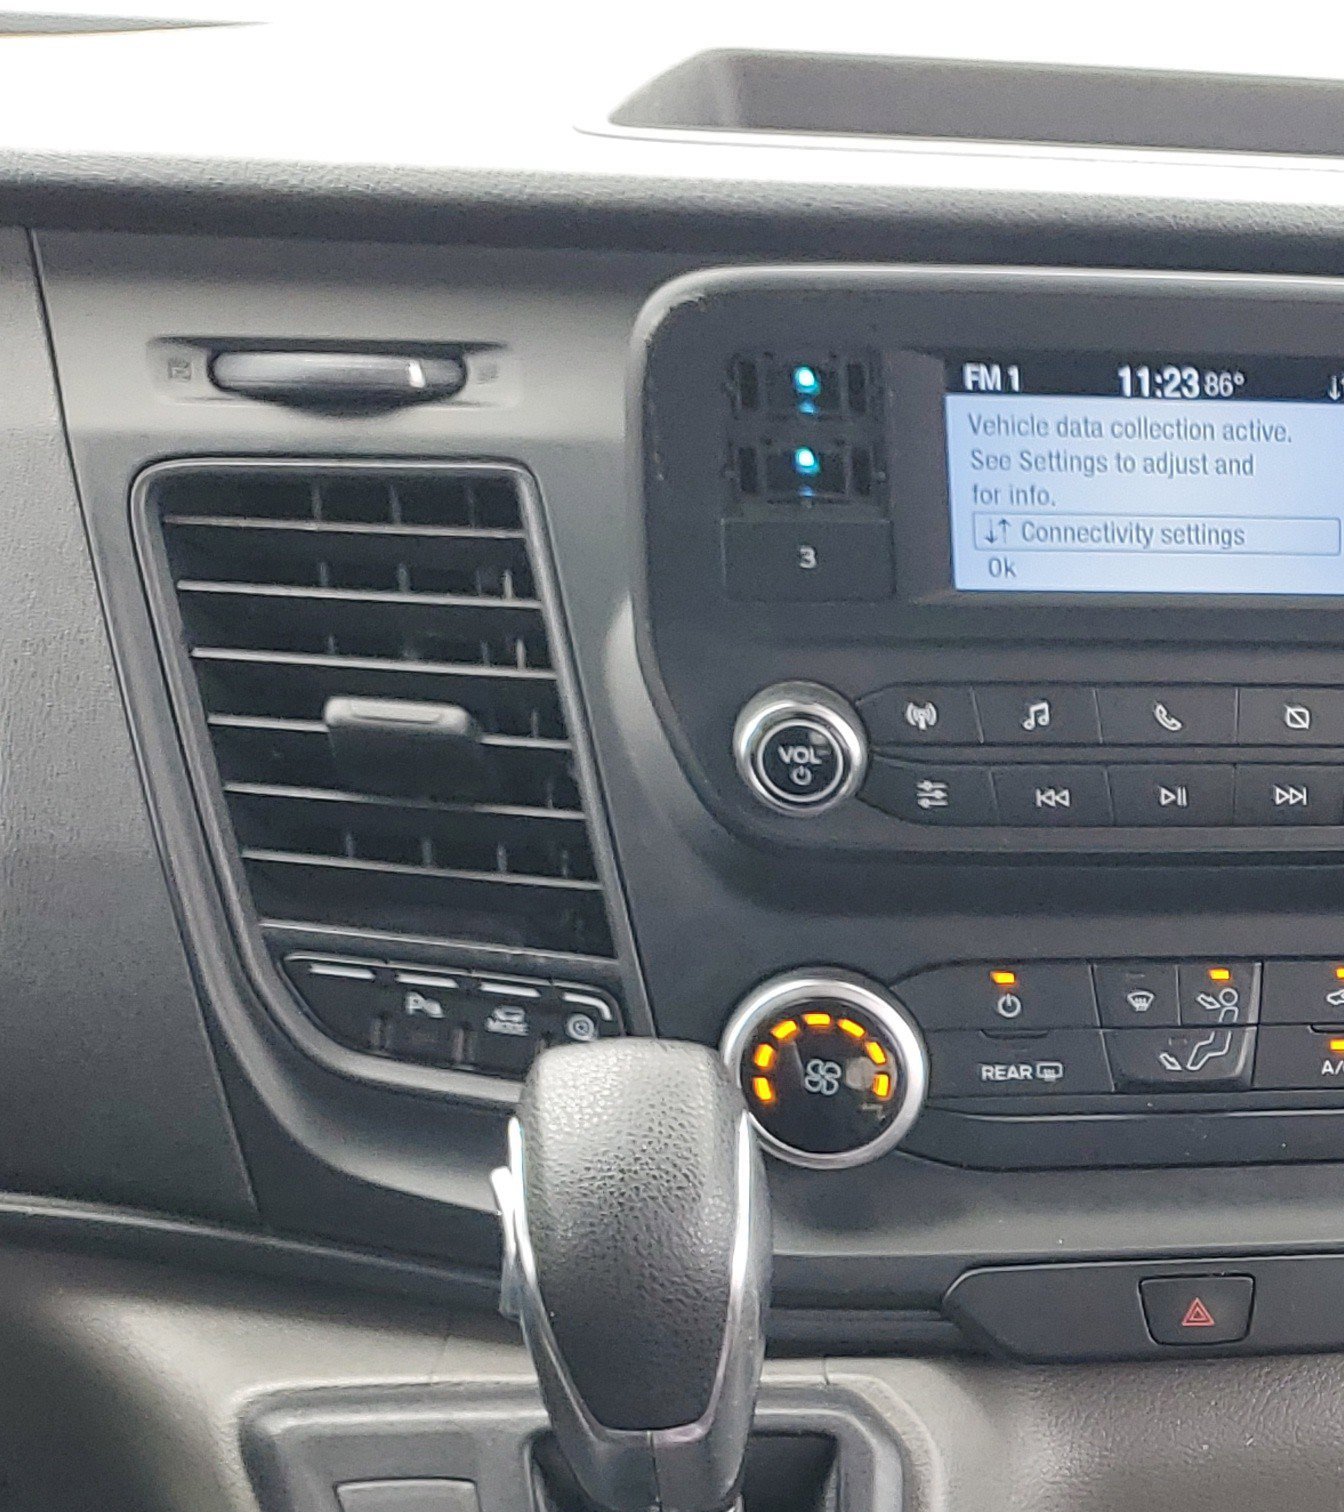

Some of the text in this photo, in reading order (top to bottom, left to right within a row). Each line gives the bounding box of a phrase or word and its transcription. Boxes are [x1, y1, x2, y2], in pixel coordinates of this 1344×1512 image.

[963, 362, 1019, 391] FM 1
[1118, 366, 1199, 398] 11:23
[968, 413, 1292, 442] Vehicle data collection active.
[971, 449, 1253, 478] See Settings to adjust and
[973, 484, 1055, 506] for info.
[1022, 521, 1245, 549] Connectivity settings
[798, 545, 818, 569] 3
[989, 557, 1016, 577] Ok
[778, 746, 822, 765] VOL
[981, 1064, 1033, 1081] REAR
